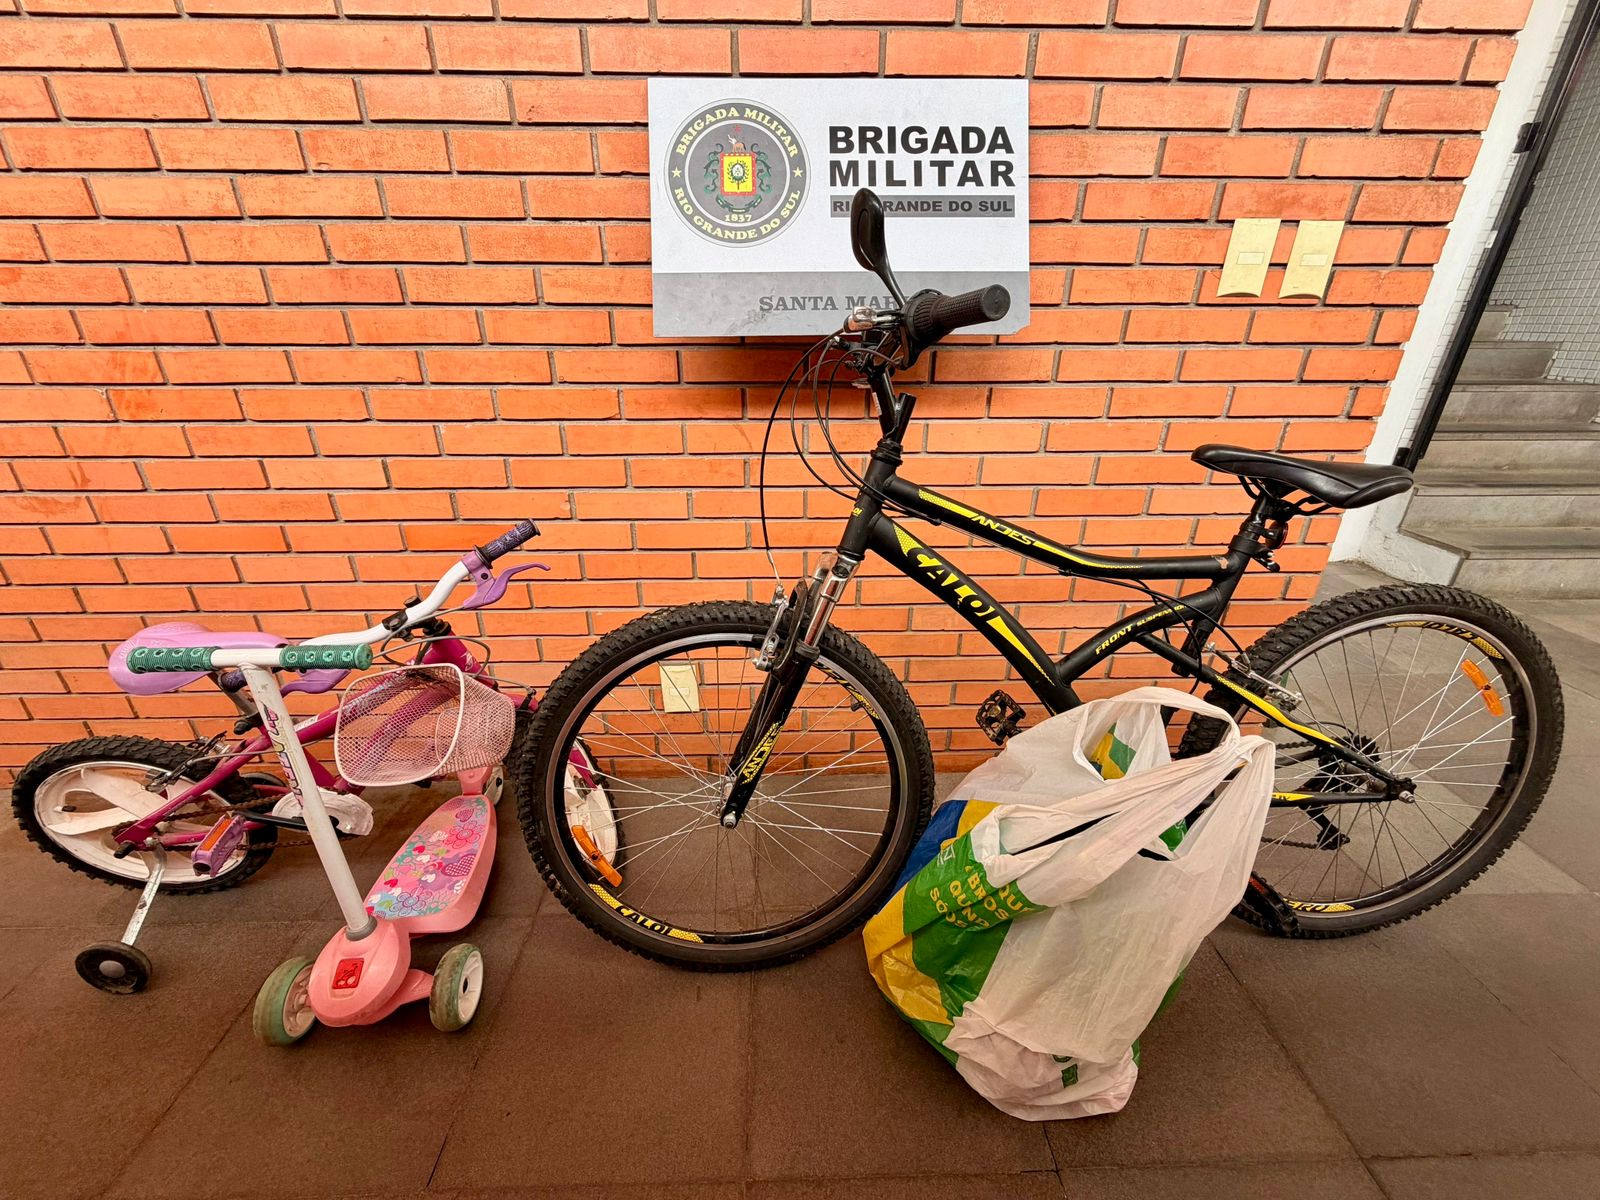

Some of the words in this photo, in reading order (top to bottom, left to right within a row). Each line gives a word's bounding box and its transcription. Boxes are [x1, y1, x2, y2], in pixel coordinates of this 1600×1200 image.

[676, 107, 740, 156] BRIGADA
[743, 107, 799, 157] MILITAR
[829, 126, 1015, 154] BRIGADA
[829, 160, 1016, 187] MILITAR
[674, 187, 694, 216] RIO
[693, 215, 758, 240] GRANDE
[760, 218, 781, 237] DO
[780, 190, 801, 218] SUL
[724, 213, 752, 222] 1837
[882, 201, 943, 212] RANDE
[948, 201, 973, 212] DO
[978, 201, 1013, 212] SUL
[759, 295, 838, 312] SANTA
[907, 547, 1000, 622] CALOI
[1095, 623, 1133, 655] FRONT
[616, 906, 672, 937] CALOI
